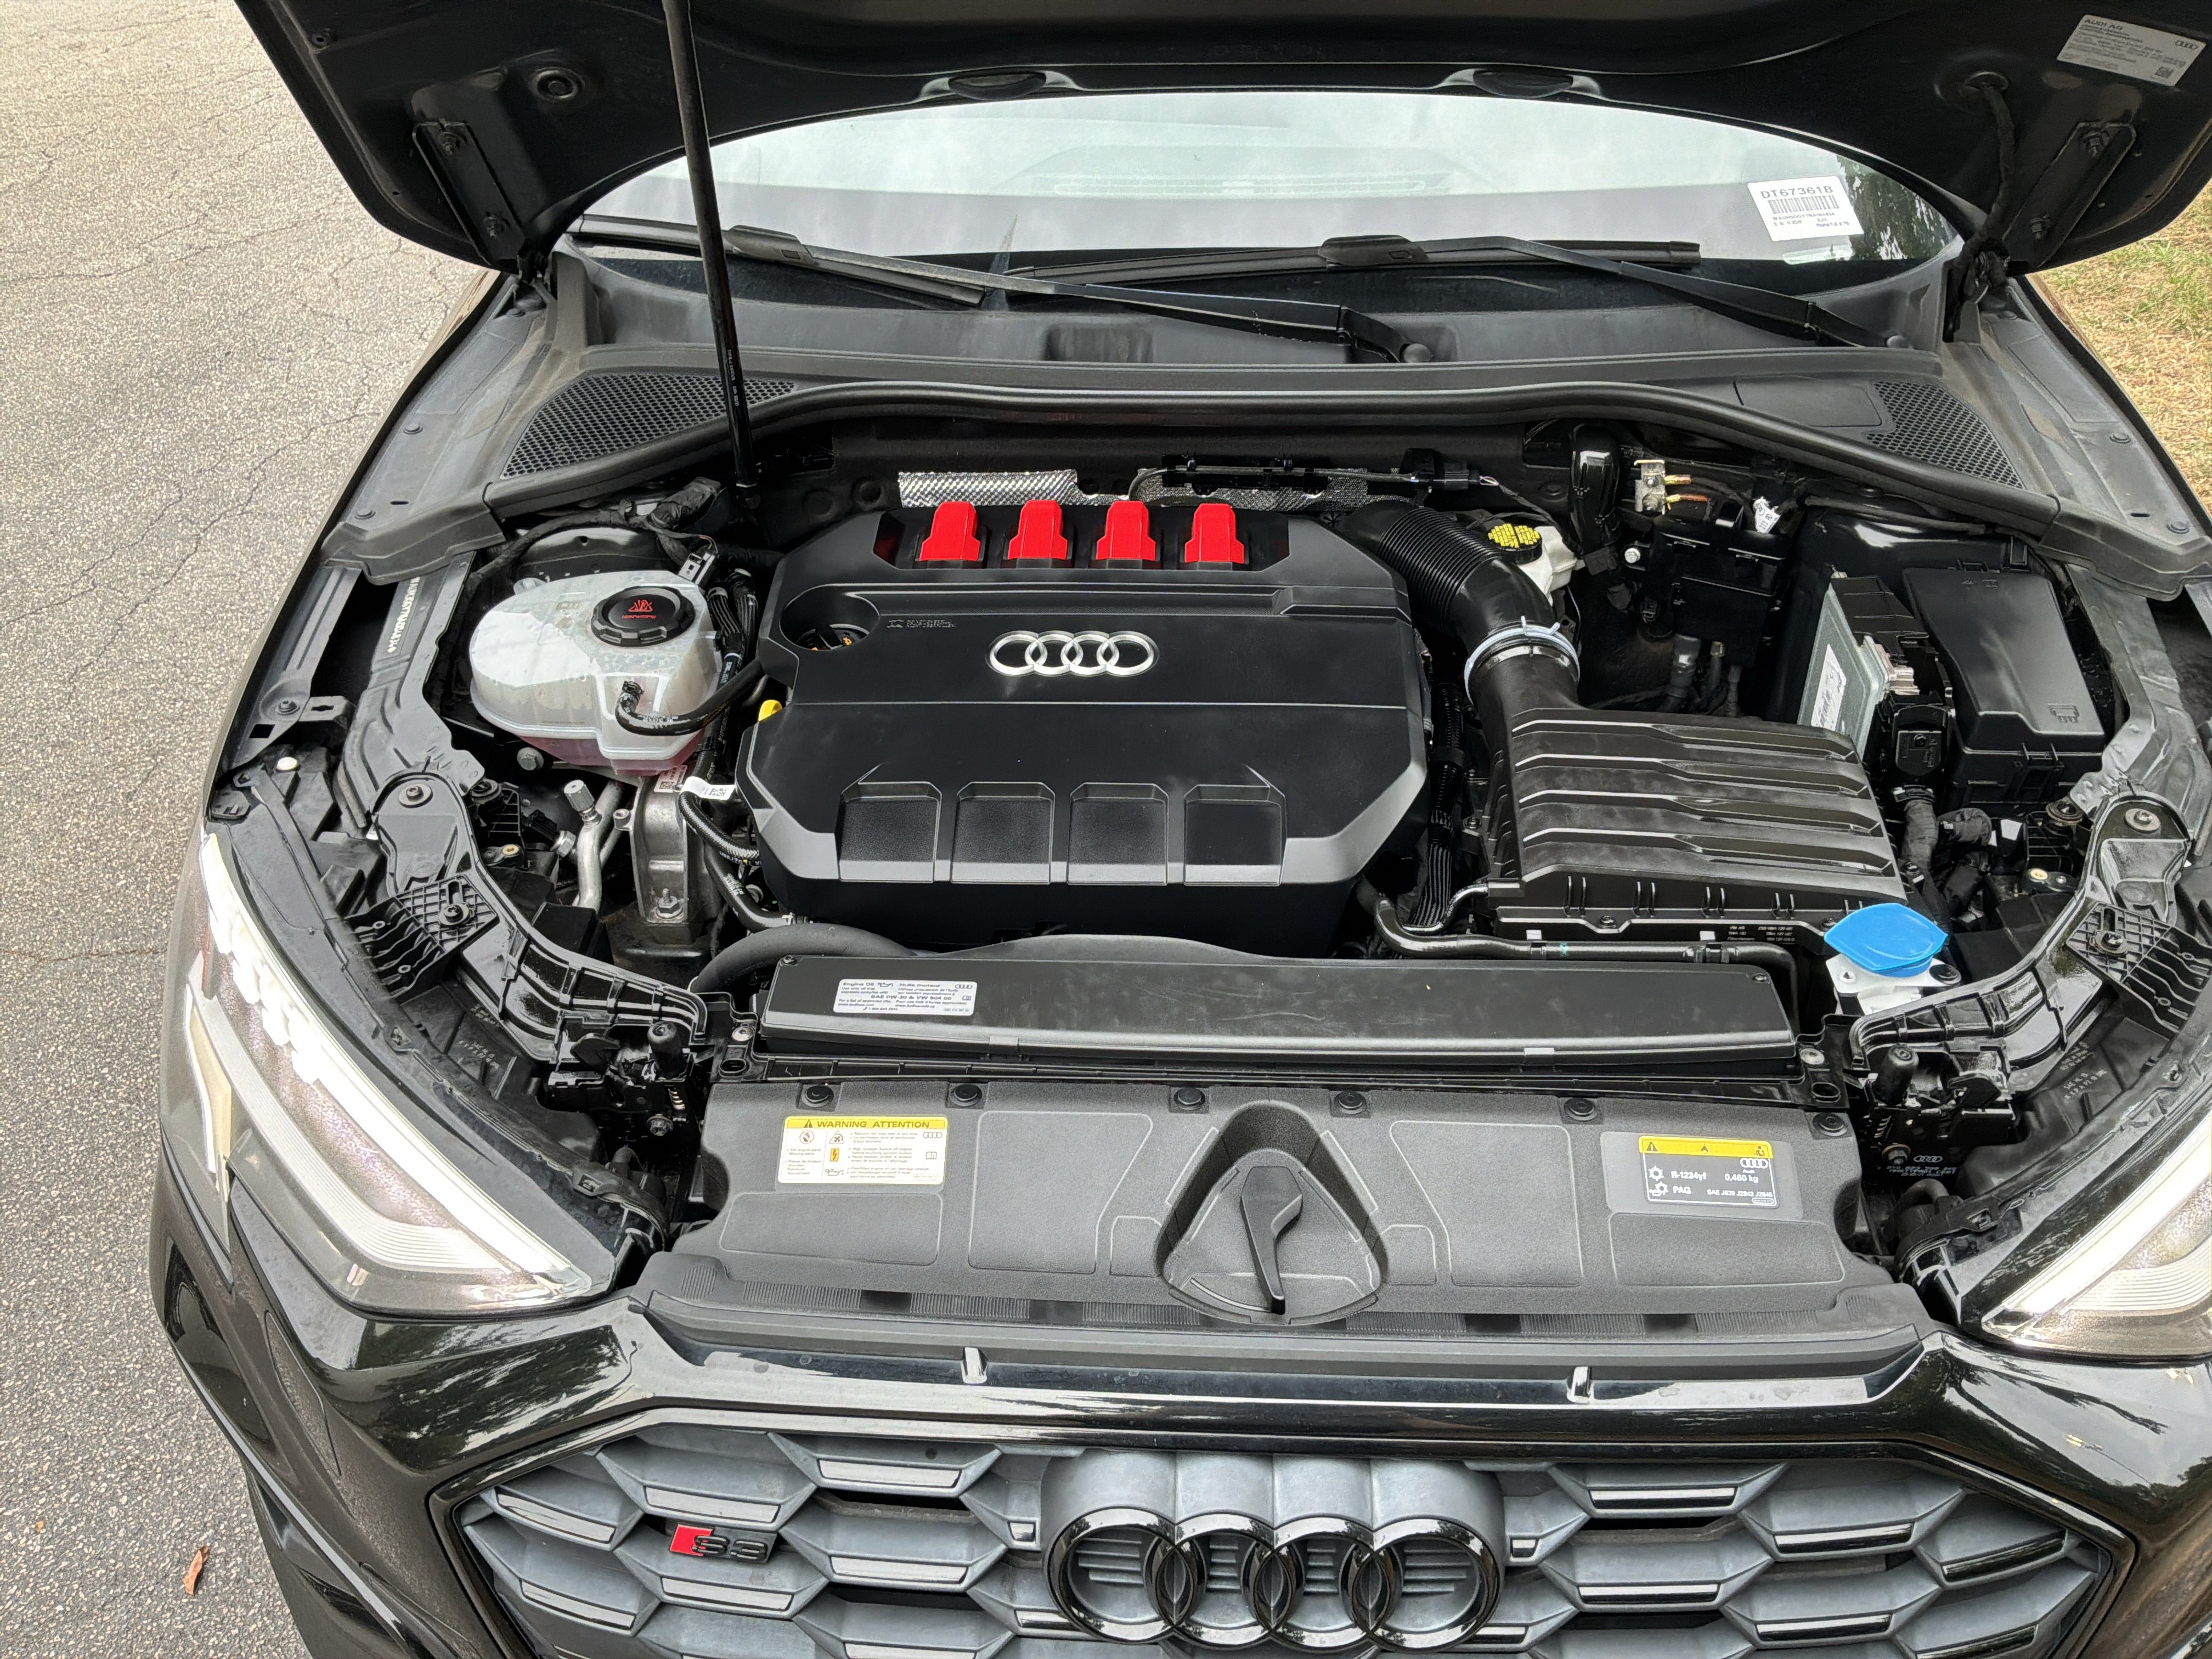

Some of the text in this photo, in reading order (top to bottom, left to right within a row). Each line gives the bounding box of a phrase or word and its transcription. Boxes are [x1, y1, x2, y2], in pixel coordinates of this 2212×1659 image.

[2084, 19, 2107, 29] AUDI
[1760, 185, 1833, 199] DT67361B
[817, 1120, 867, 1128] WARNING
[1671, 1171, 1707, 1181] R-1234yf
[1748, 1175, 1759, 1184] kg
[1673, 1186, 1692, 1195] PAG
[691, 1534, 768, 1560] S3
